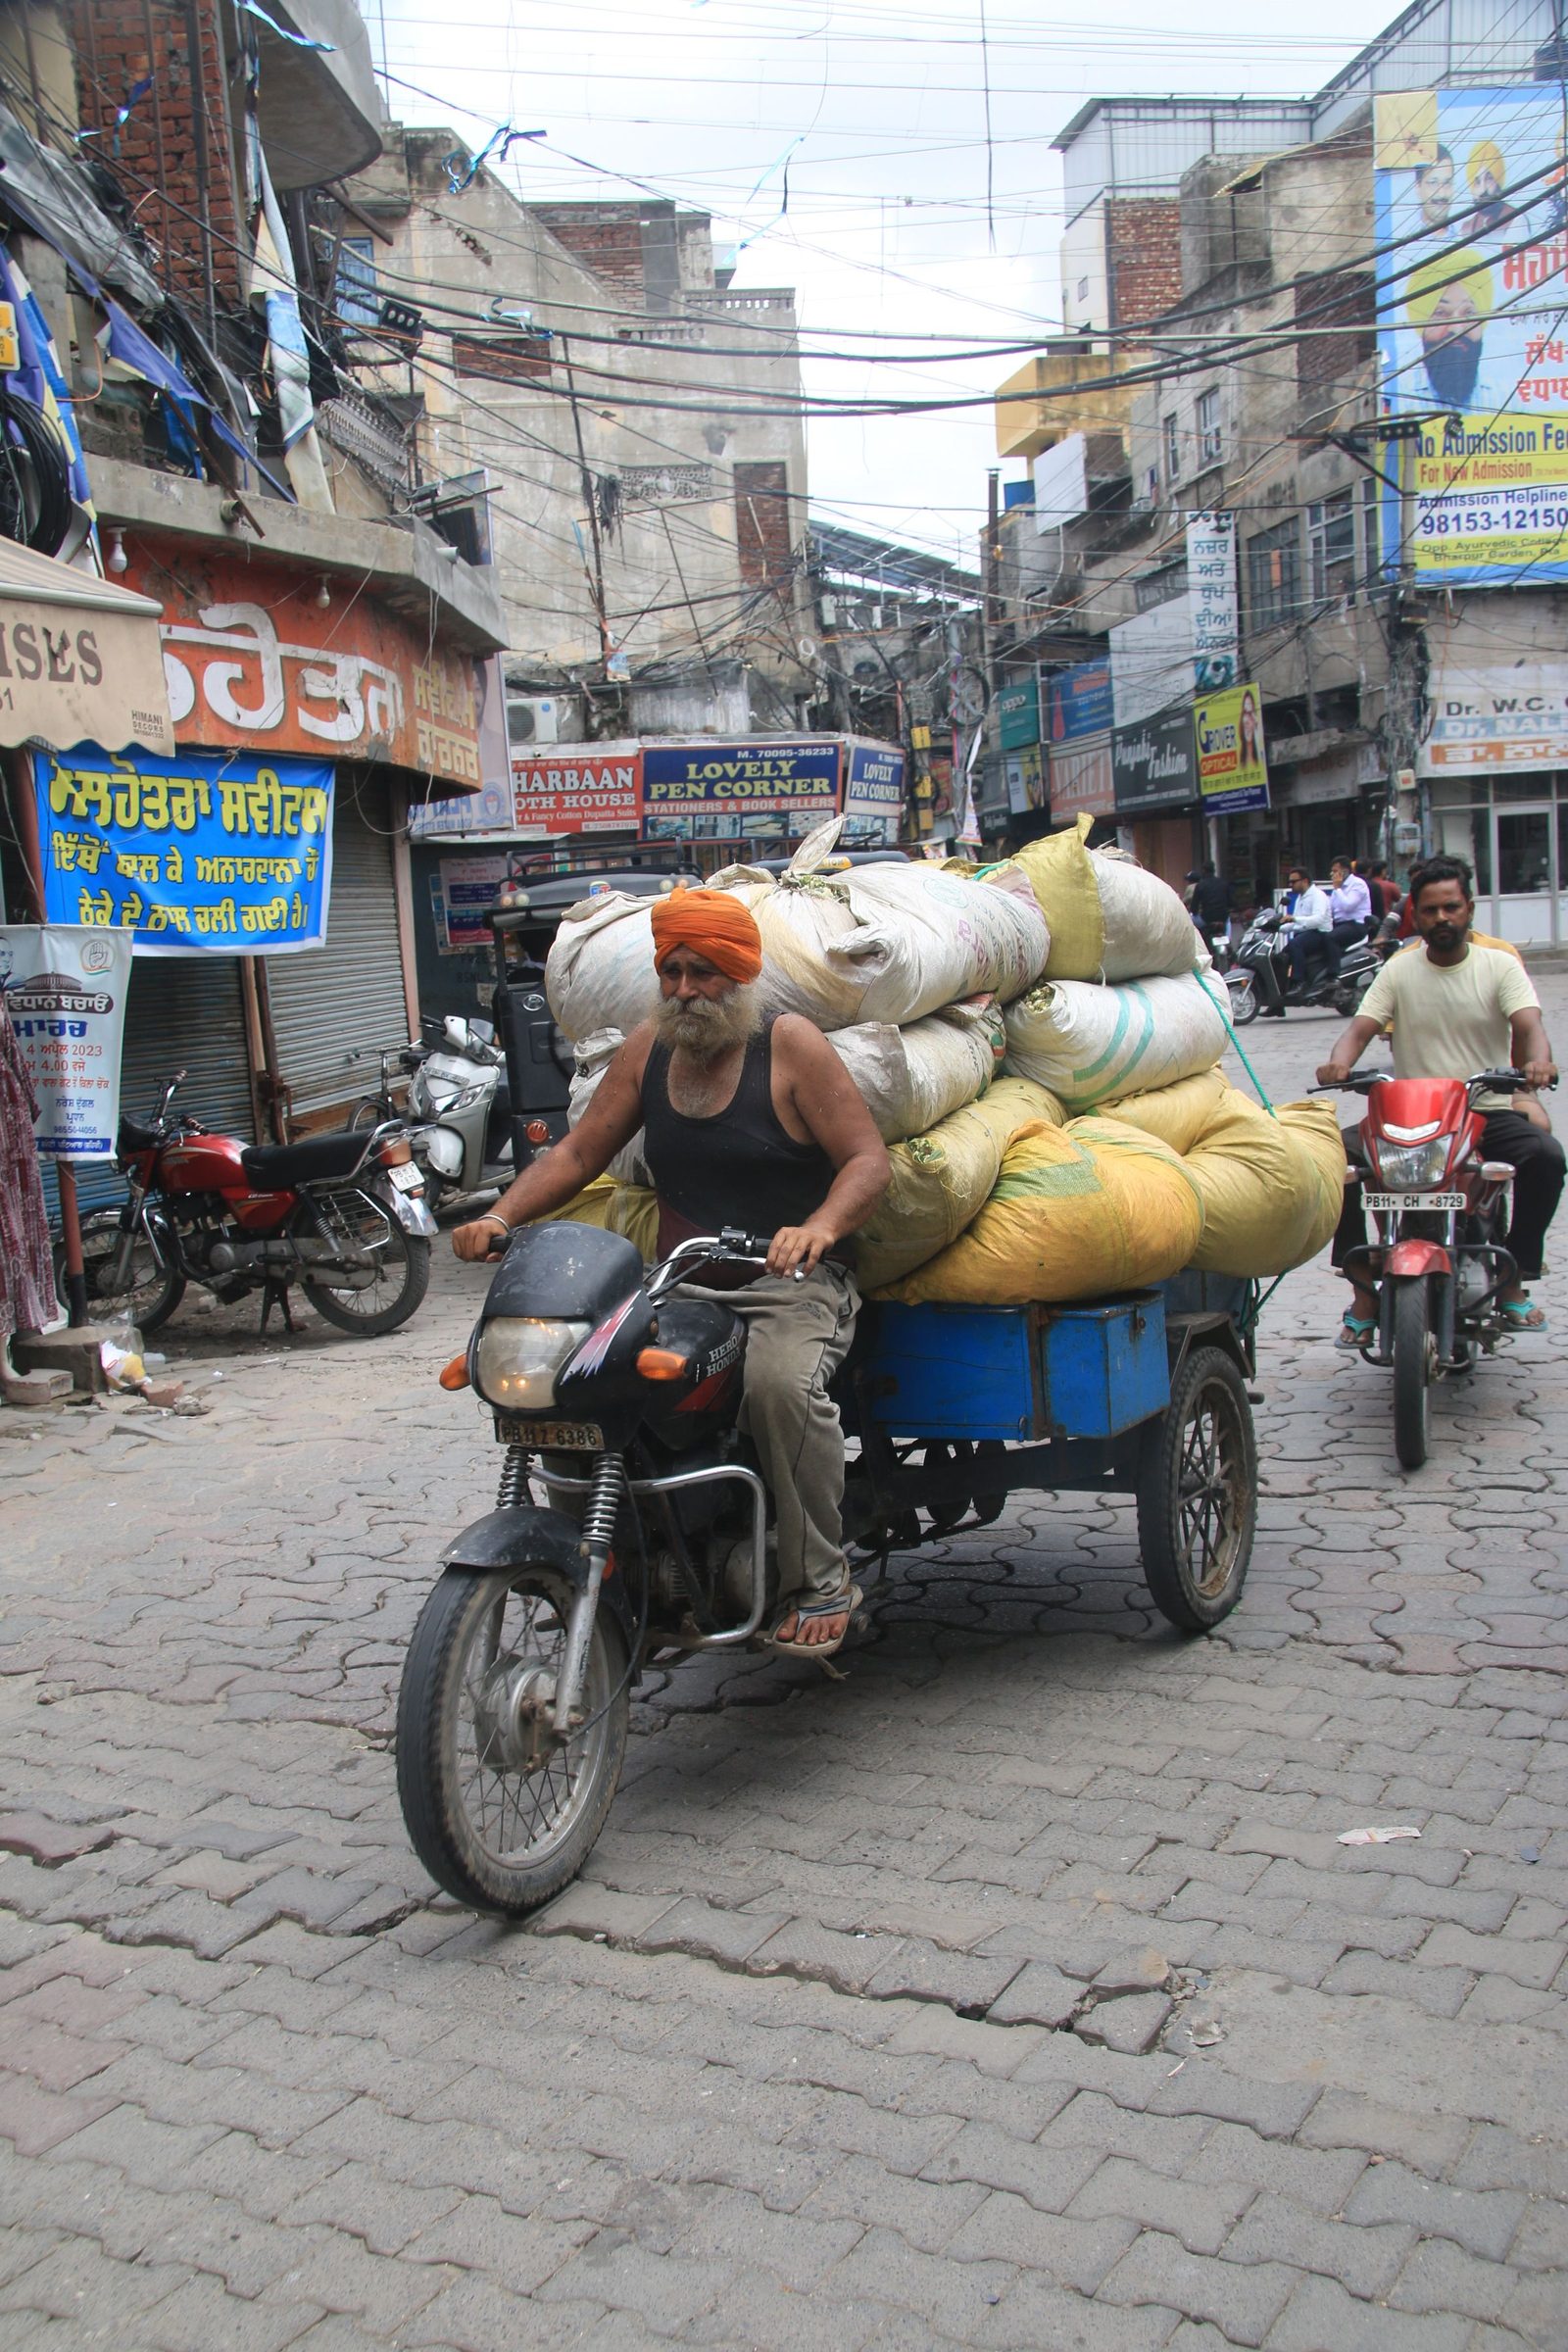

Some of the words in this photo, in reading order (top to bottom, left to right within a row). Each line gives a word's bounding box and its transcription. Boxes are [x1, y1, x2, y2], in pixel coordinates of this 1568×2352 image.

[1415, 429, 1435, 458] No
[1443, 425, 1537, 458] Admission
[1543, 422, 1568, 451] Fe
[1420, 464, 1440, 484] For
[1444, 462, 1468, 481] New
[1472, 459, 1533, 480] Admission
[1418, 492, 1499, 510] Admission
[1504, 488, 1568, 507] Helpline
[1422, 507, 1568, 535] 98153-12150
[1455, 540, 1518, 552] Ayurvedic
[1002, 694, 1027, 713] oppo
[1446, 701, 1481, 716] Dr.
[1492, 696, 1555, 714] W.C.
[131, 710, 163, 725] HIMANI
[132, 721, 164, 733] DECORS
[1198, 711, 1238, 755] GROVER
[737, 750, 754, 760] M.
[758, 746, 835, 759] 70095-36233
[1148, 743, 1190, 781] Fashion
[687, 760, 798, 781] LOVELY
[862, 762, 895, 782] LOVELY
[1200, 757, 1238, 775] OPTICAL
[50, 754, 212, 830] ਮਲਹੋਤਰਾ
[218, 767, 328, 834] ਸਵੀਟਸ
[650, 781, 710, 801] PEN
[713, 777, 832, 799] CORNER
[851, 781, 869, 799] PEN
[868, 783, 901, 802] CORNER
[563, 792, 636, 808] HOUSE
[644, 802, 723, 815] STATIONERS
[727, 801, 737, 812] &
[741, 798, 777, 811] BOOK
[780, 797, 836, 810] SELLERS
[531, 810, 555, 821] Fancy
[556, 808, 582, 820] Cotton
[616, 807, 637, 818] Suits
[165, 846, 185, 883] ਕੇ
[72, 1044, 103, 1056] 2023
[40, 1059, 69, 1072] 4.00
[1402, 1196, 1420, 1207] CH
[1435, 1196, 1463, 1207] 8729
[708, 1335, 738, 1363] HERO
[706, 1347, 742, 1378] HONDA
[556, 1427, 597, 1446] 6386
